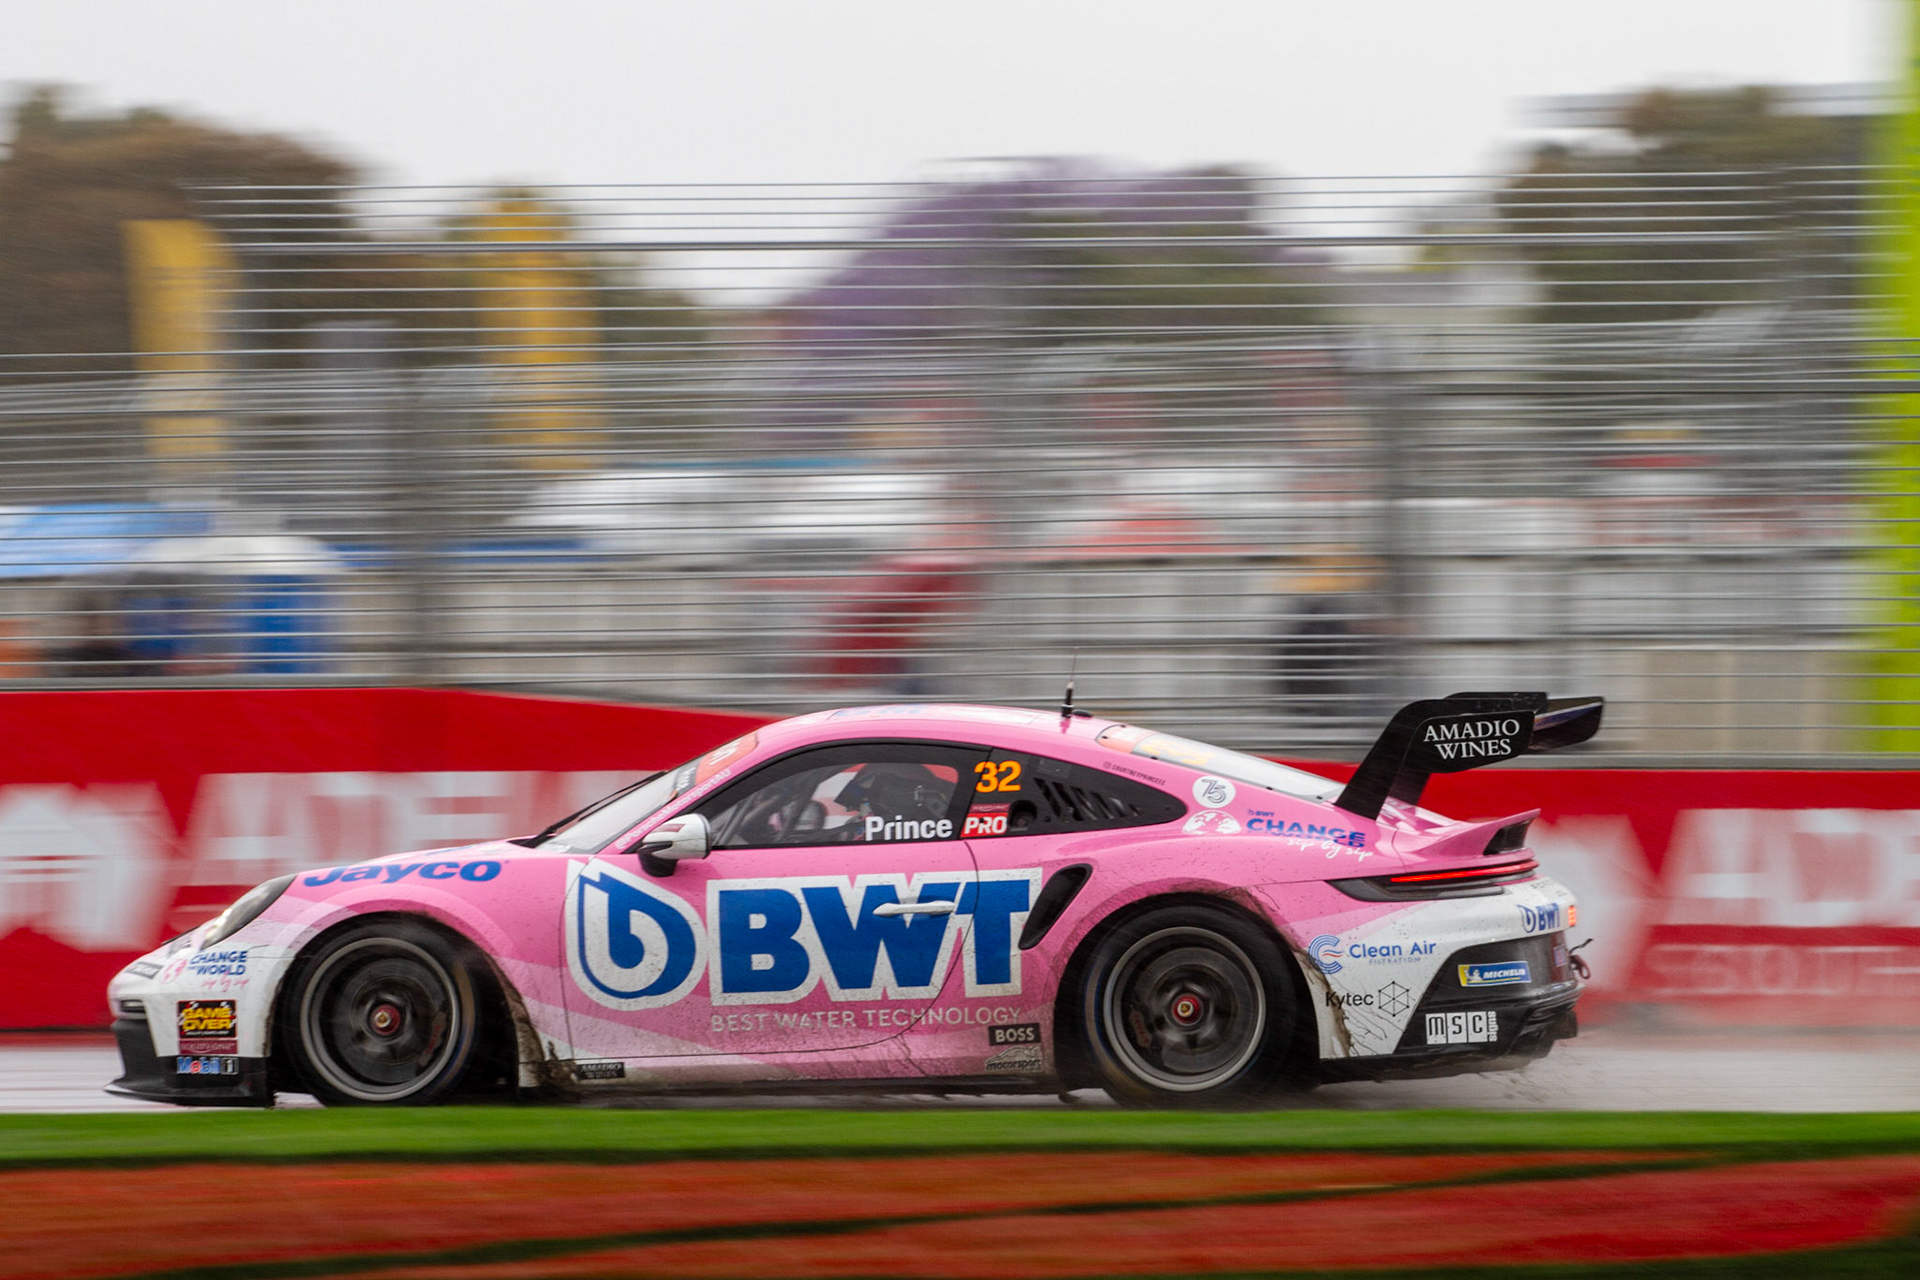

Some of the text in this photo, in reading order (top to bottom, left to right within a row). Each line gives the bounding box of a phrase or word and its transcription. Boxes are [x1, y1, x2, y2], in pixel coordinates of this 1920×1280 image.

[1423, 719, 1520, 742] AMADIO
[1434, 739, 1512, 759] WINES
[974, 760, 1022, 793] 32
[865, 815, 953, 841] Prince
[964, 816, 1008, 835] PRO
[1246, 818, 1366, 841] CHANGE
[1287, 839, 1315, 851] sip
[1321, 840, 1341, 858] by
[1345, 847, 1374, 862] sip
[303, 860, 502, 887] Jayco
[718, 878, 1031, 994] BWT
[189, 950, 248, 965] CHANGE
[1349, 940, 1437, 958] Clean Air
[196, 964, 246, 976] WORLD
[1325, 991, 1375, 1010] Kytec
[182, 1007, 232, 1019] GAME
[711, 1006, 1022, 1033] BEST WATER TECHNOLOGY
[182, 1019, 231, 1031] OVER
[994, 1027, 1035, 1044] BOSS
[176, 1056, 220, 1075] Mobil
[986, 1059, 1041, 1071] motorsport
